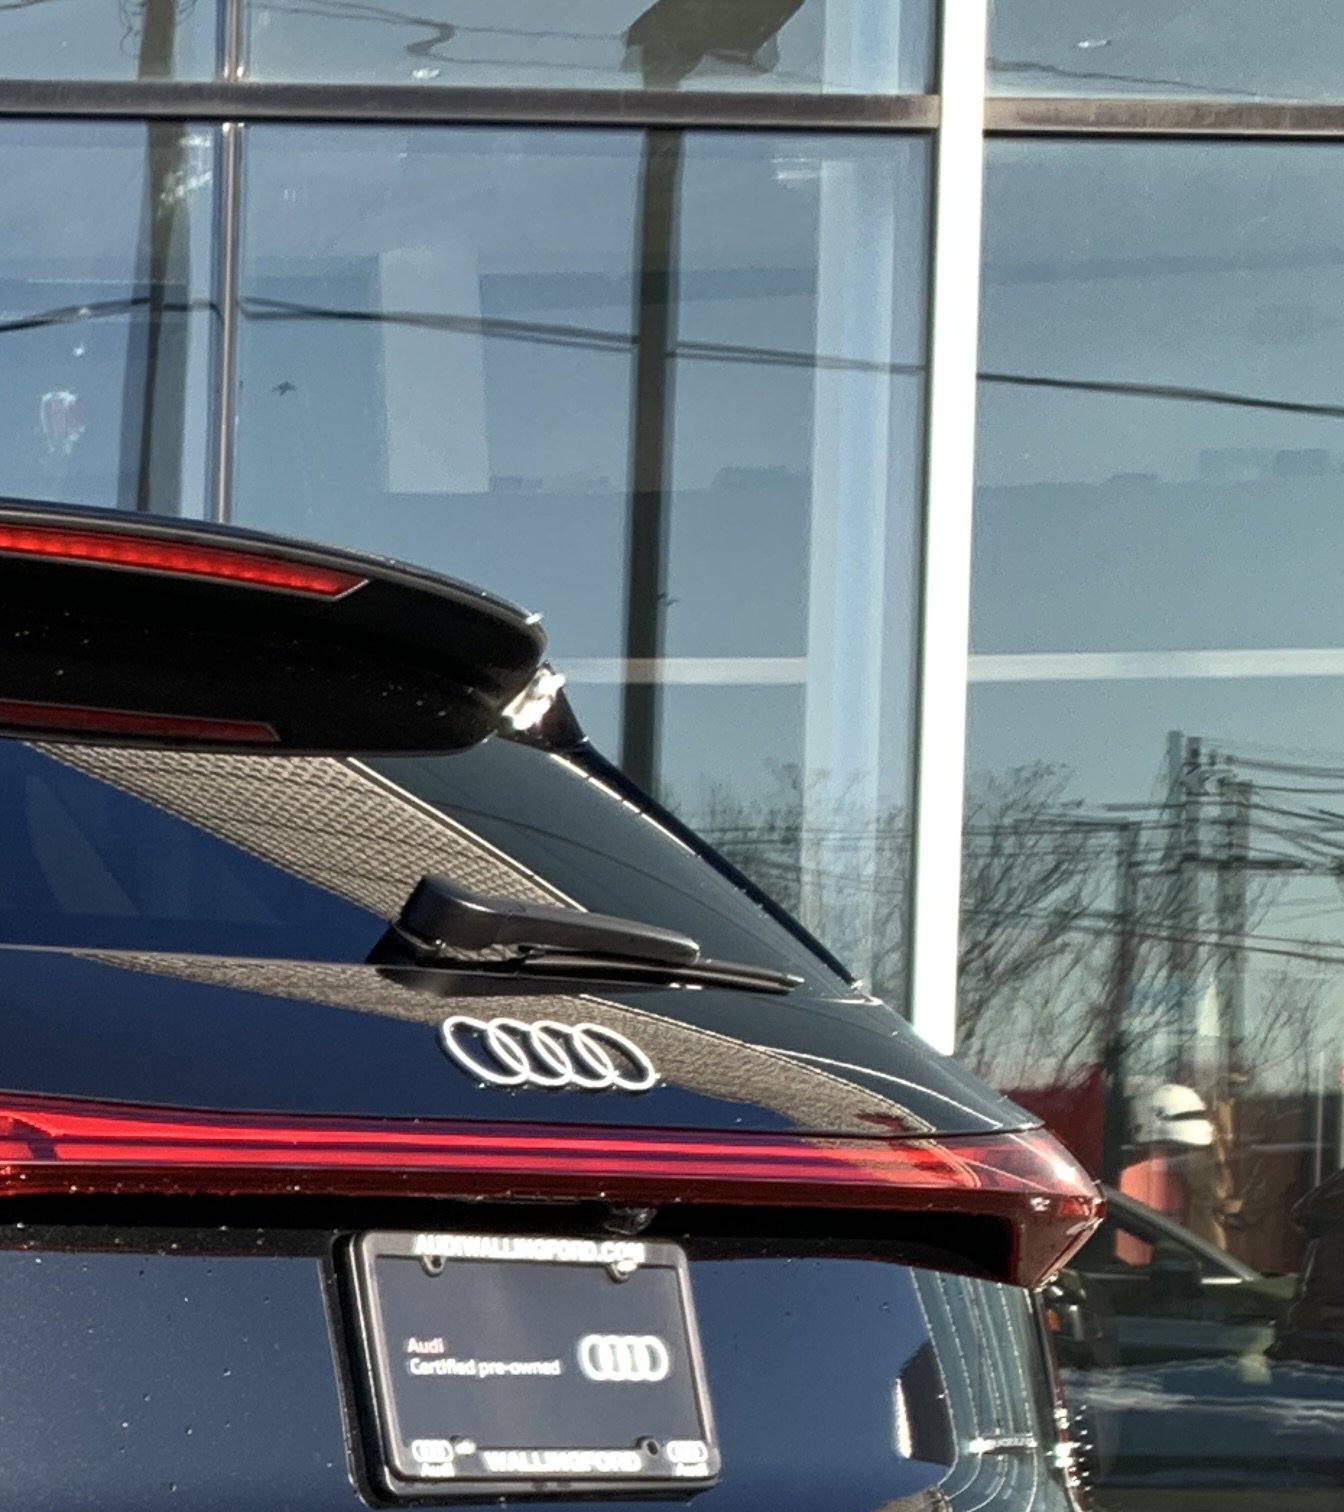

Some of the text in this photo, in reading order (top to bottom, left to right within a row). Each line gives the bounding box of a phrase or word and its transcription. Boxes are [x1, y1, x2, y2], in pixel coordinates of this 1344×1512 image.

[407, 1337, 445, 1354] Audi
[410, 1358, 562, 1378] Certified pre-owned
[483, 1450, 642, 1472] WALLINGFORD
